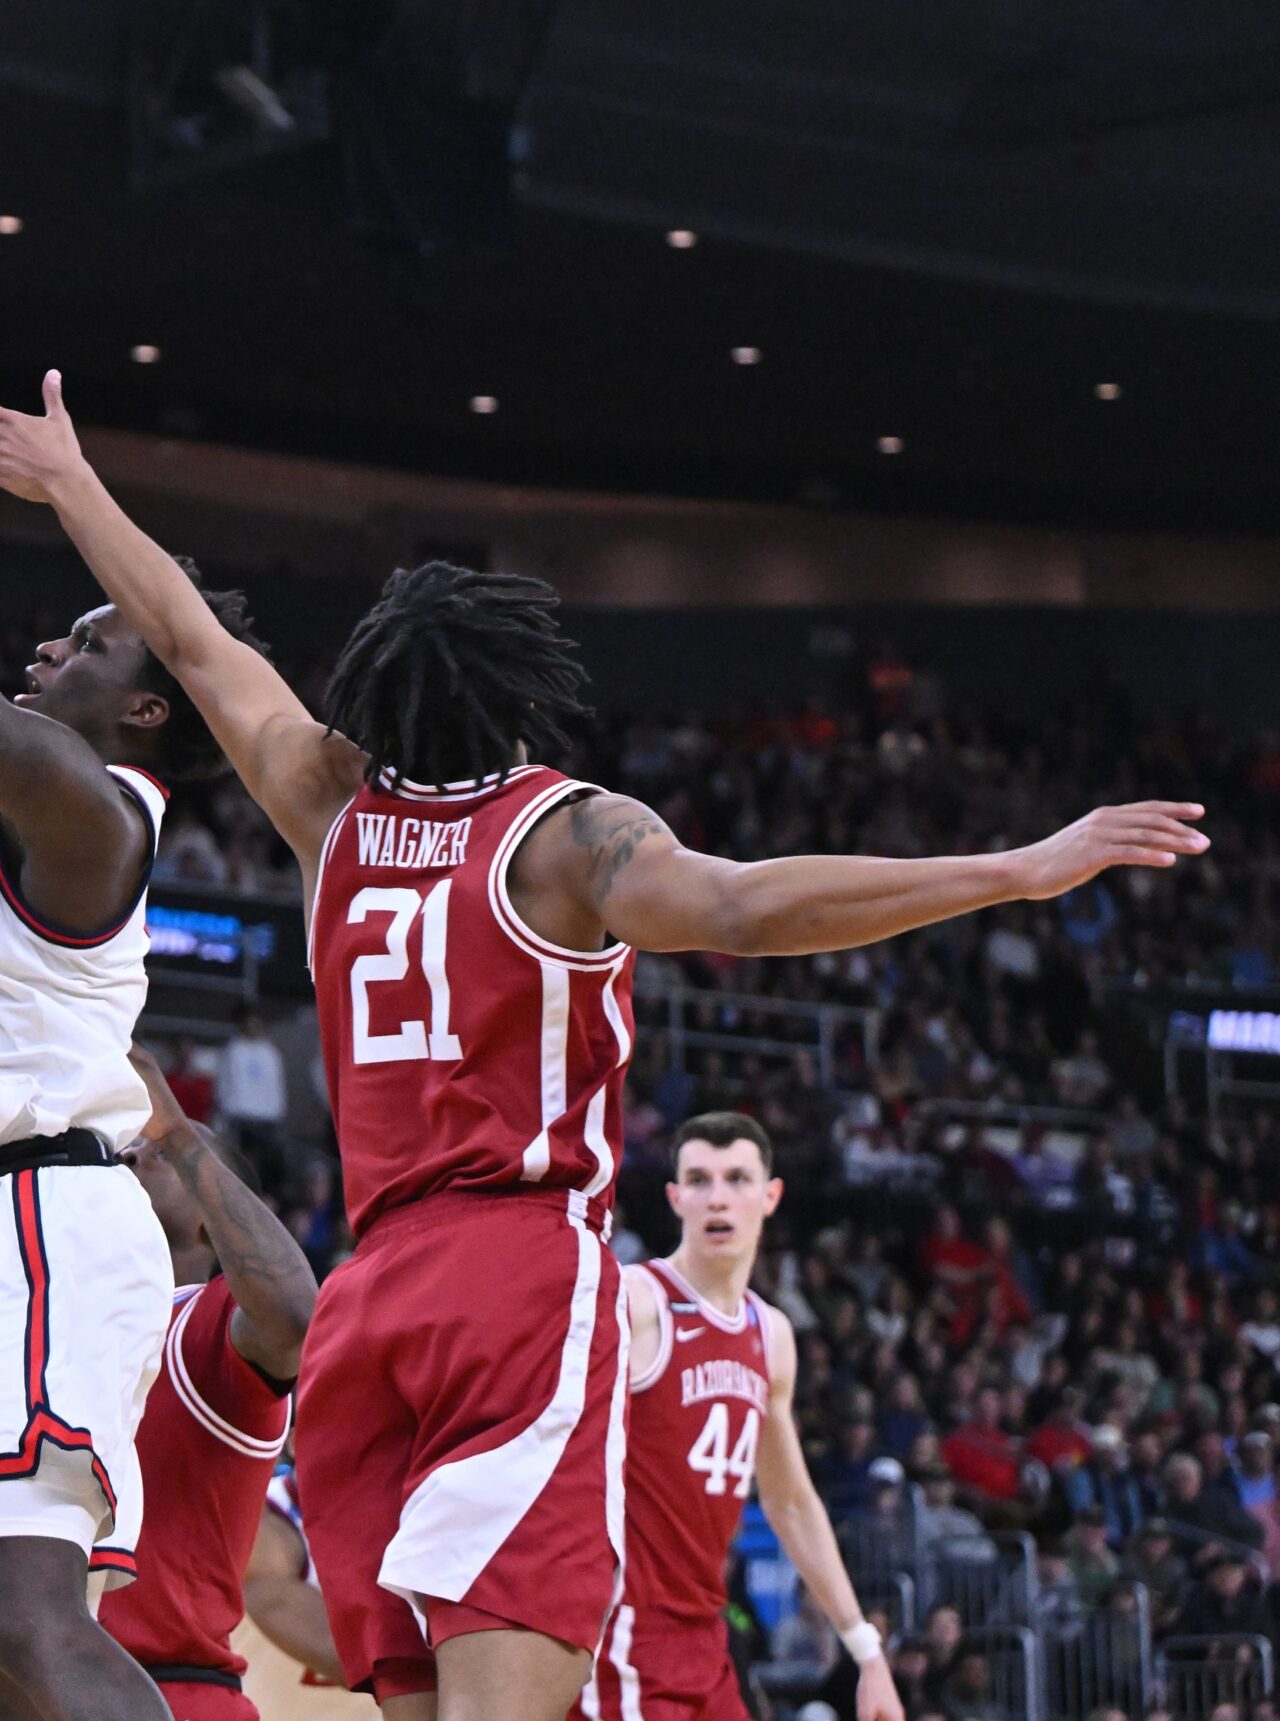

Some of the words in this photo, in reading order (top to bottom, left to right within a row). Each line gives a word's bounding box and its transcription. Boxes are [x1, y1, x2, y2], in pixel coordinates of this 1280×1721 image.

[356, 811, 472, 869] WAGNER
[346, 878, 464, 1064] 21
[687, 1403, 760, 1498] 44
